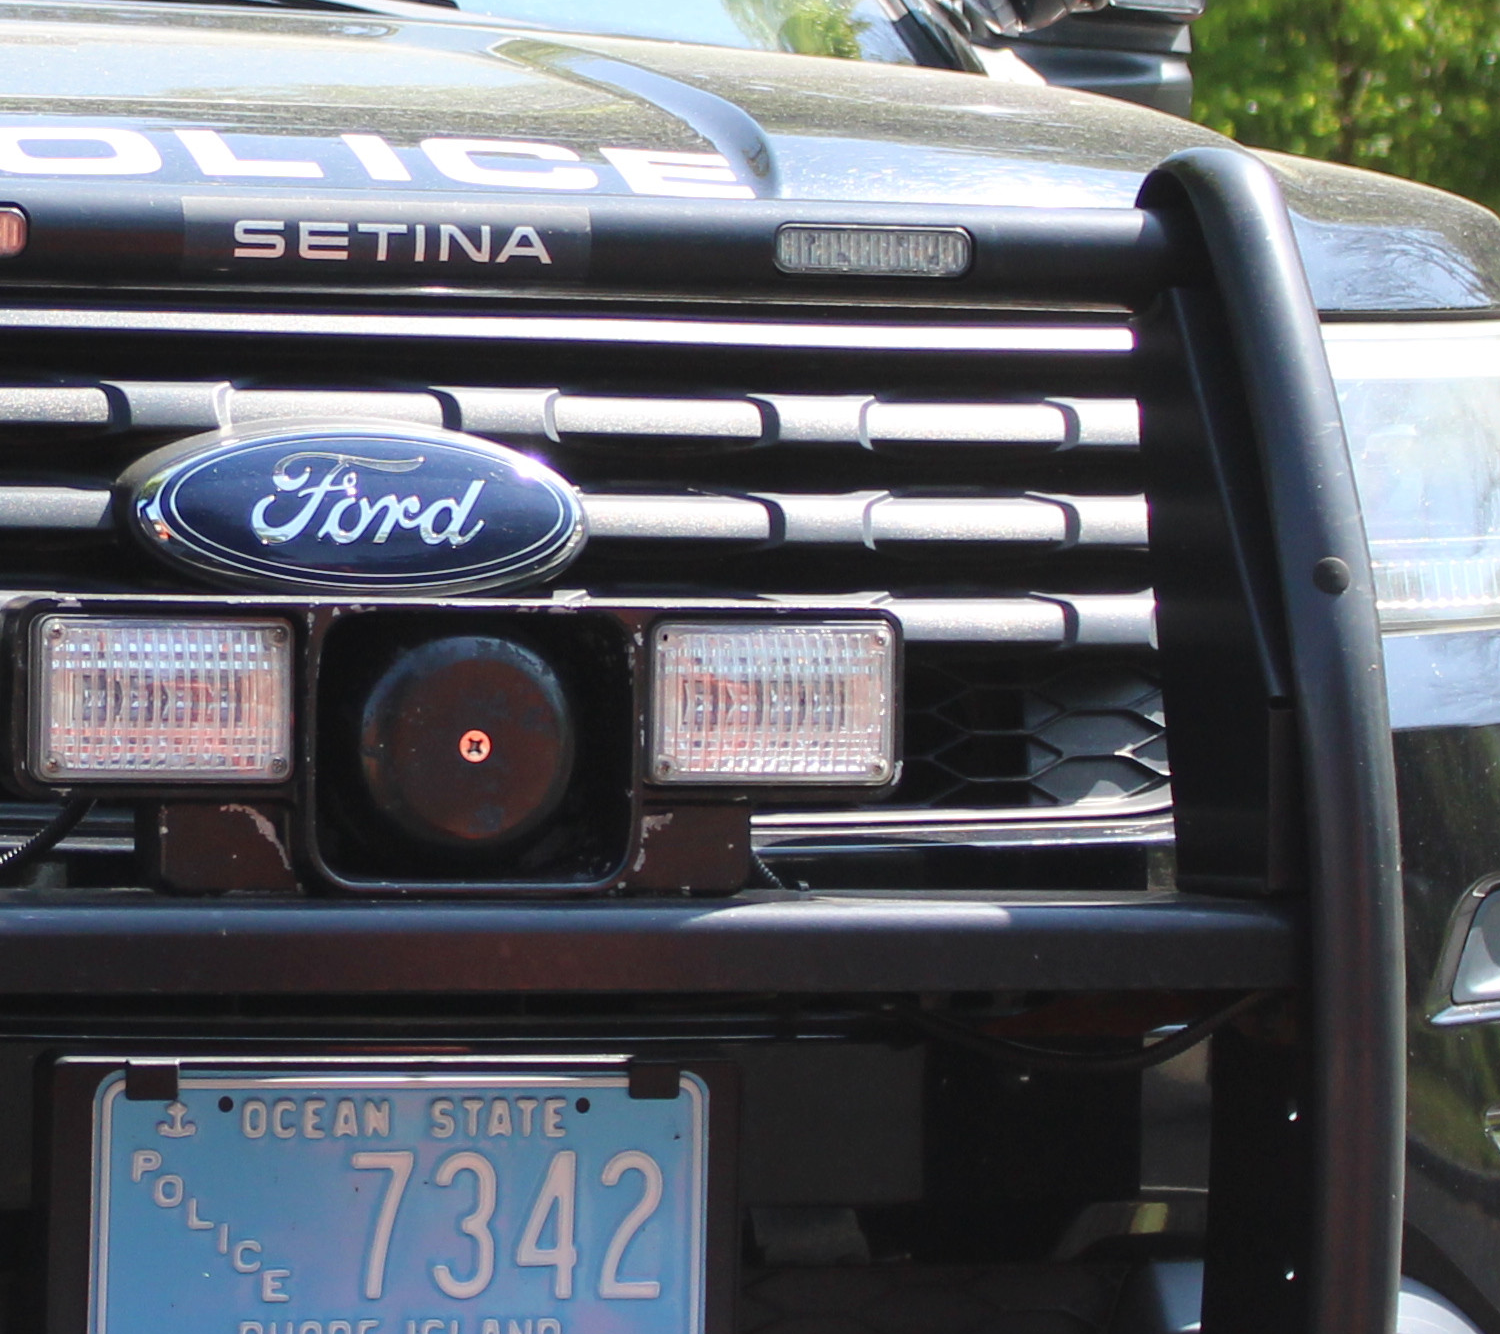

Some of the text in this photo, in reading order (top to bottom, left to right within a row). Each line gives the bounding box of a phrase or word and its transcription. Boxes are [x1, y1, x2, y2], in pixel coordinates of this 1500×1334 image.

[234, 219, 552, 265] SETINA
[252, 452, 486, 548] Ford
[241, 1097, 568, 1139] OCEAN STATE
[131, 1150, 291, 1303] POLICE
[351, 1150, 663, 1301] 7342
